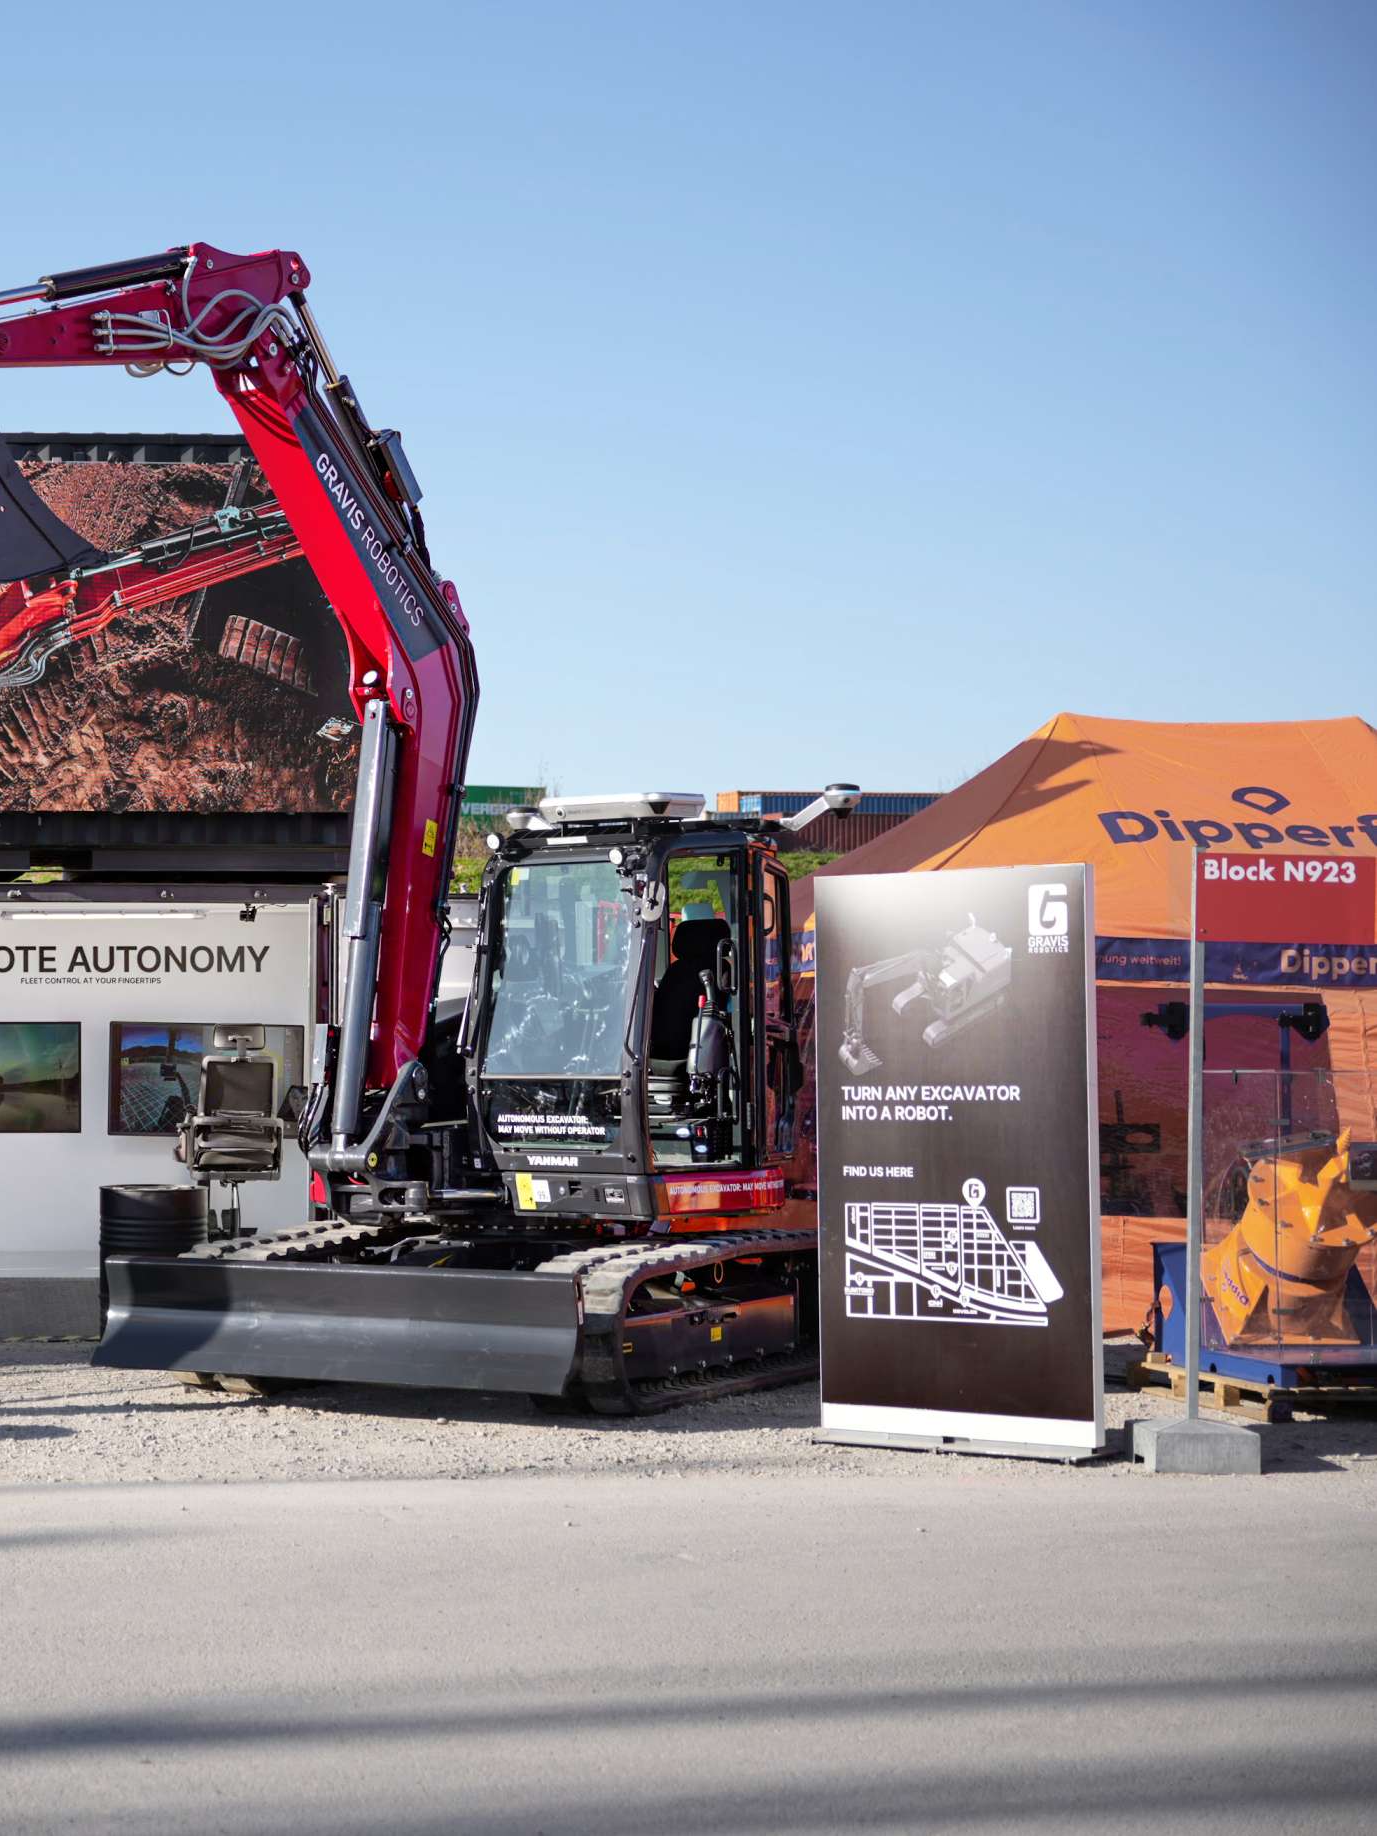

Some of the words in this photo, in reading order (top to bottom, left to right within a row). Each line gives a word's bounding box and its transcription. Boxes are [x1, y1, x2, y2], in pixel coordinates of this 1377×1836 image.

[316, 453, 365, 530] GRAVIS
[361, 526, 424, 627] ROBOTICS
[1203, 858, 1276, 882] Block
[1283, 860, 1357, 884] N923
[1028, 935, 1069, 948] GRAVIS
[1028, 946, 1069, 954] ROBOTICS
[67, 945, 270, 973] AUTONOMY
[20, 977, 43, 985] FLEET
[44, 977, 82, 985] CONTROL
[83, 977, 93, 985] AT
[95, 977, 118, 985] YOUR
[118, 977, 162, 985] FINGERTIPS
[841, 1086, 882, 1101] TURN
[885, 1086, 918, 1101] ANY
[921, 1085, 1021, 1101] EXCAVATOR
[497, 1114, 545, 1123] AUTONOMOUS
[841, 1105, 878, 1121] INTO
[880, 1106, 892, 1121] A
[894, 1106, 953, 1121] ROBOT.
[498, 1125, 513, 1134] MAY
[513, 1125, 534, 1134] MOVE
[534, 1125, 567, 1134] WITHOUT
[567, 1126, 606, 1135] OPERATOR
[527, 1156, 579, 1167] YANMAR
[843, 1165, 867, 1177] FIND
[869, 1166, 884, 1177] US
[885, 1166, 914, 1178] HERE
